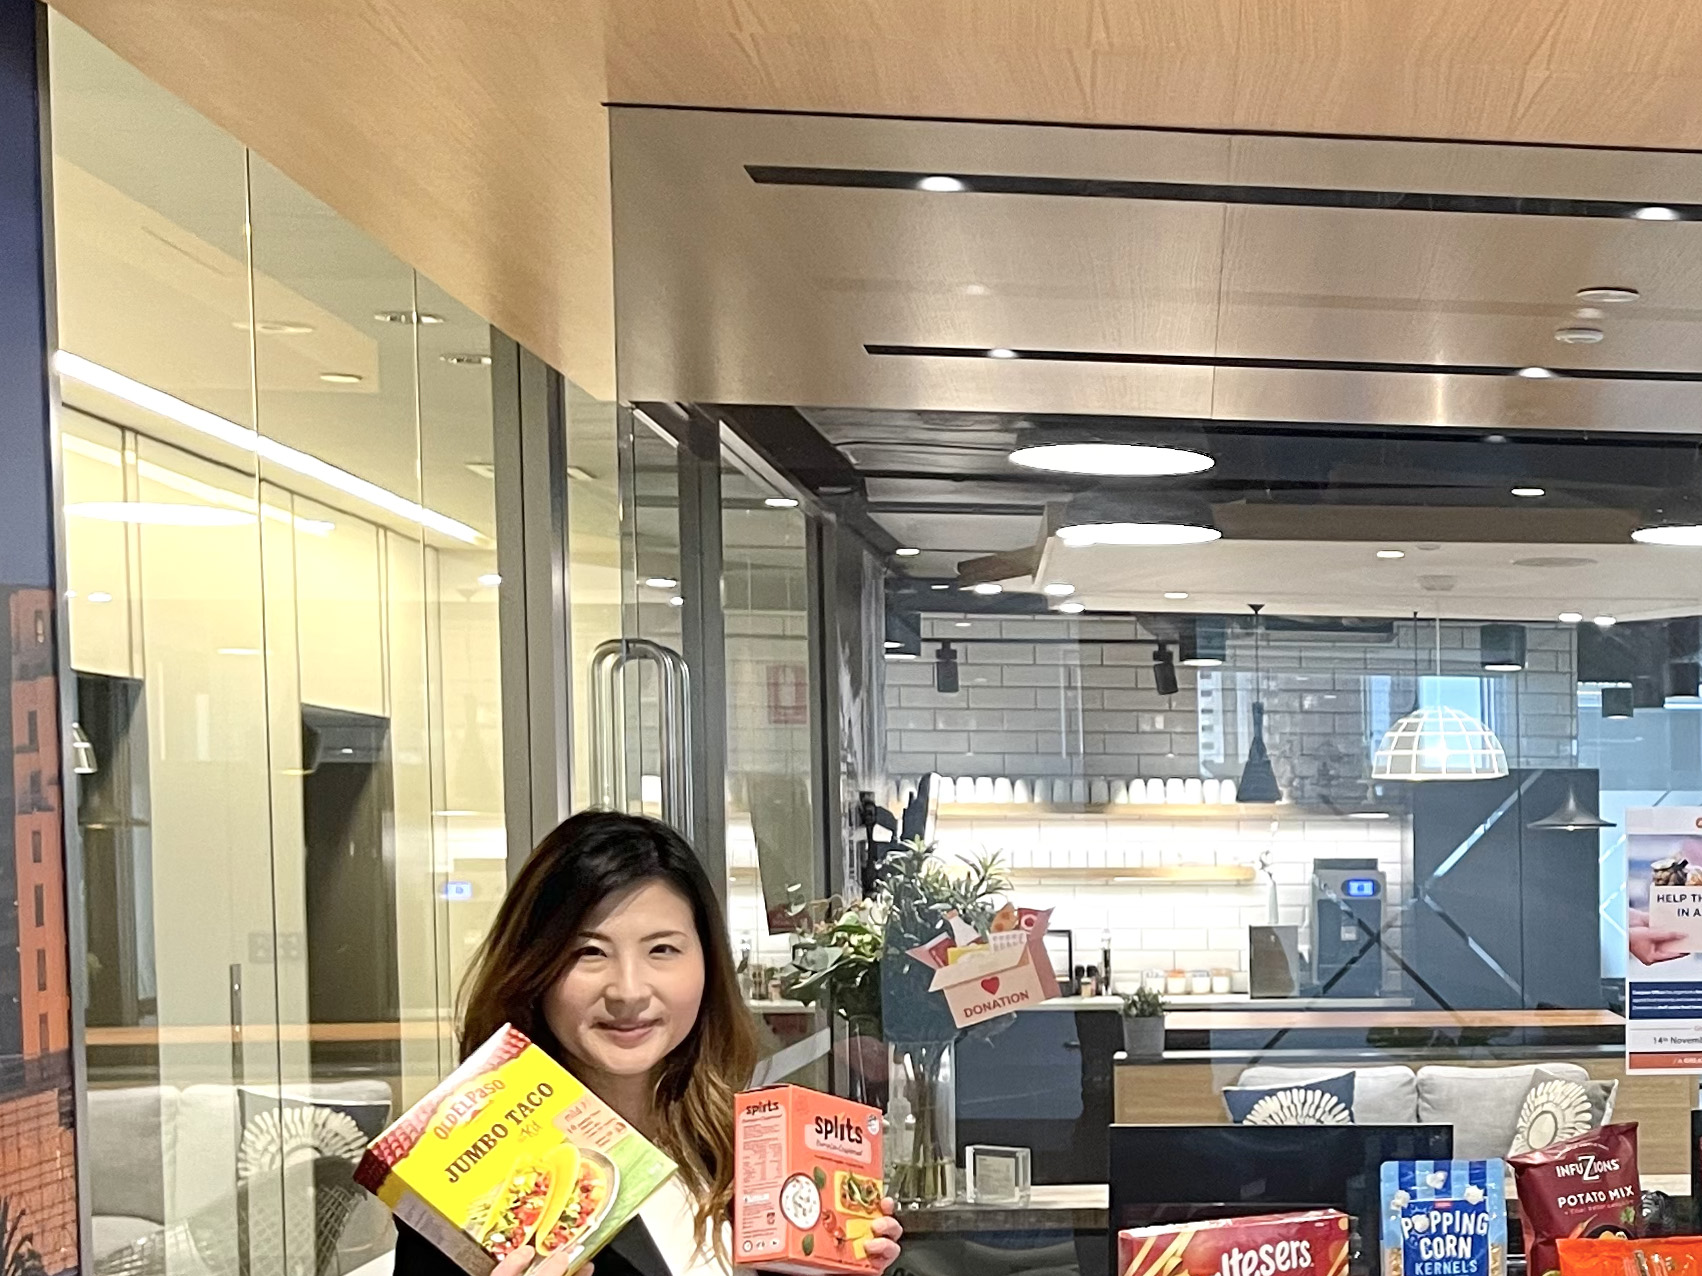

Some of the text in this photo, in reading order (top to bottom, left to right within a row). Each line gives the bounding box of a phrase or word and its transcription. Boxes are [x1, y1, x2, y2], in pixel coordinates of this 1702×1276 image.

[1657, 894, 1687, 902] HELP
[1678, 908, 1689, 916] IN
[964, 990, 1030, 1018] DONATION
[445, 1124, 508, 1183] JUMBO
[505, 1082, 554, 1125] TACO
[815, 1112, 863, 1144] splits
[1556, 1155, 1620, 1180] INFUZIONS
[1558, 1185, 1634, 1208] POTATO MIX
[1402, 1210, 1489, 1239] POPPING
[1420, 1235, 1472, 1260] CORN
[1415, 1260, 1477, 1276] KERNELS
